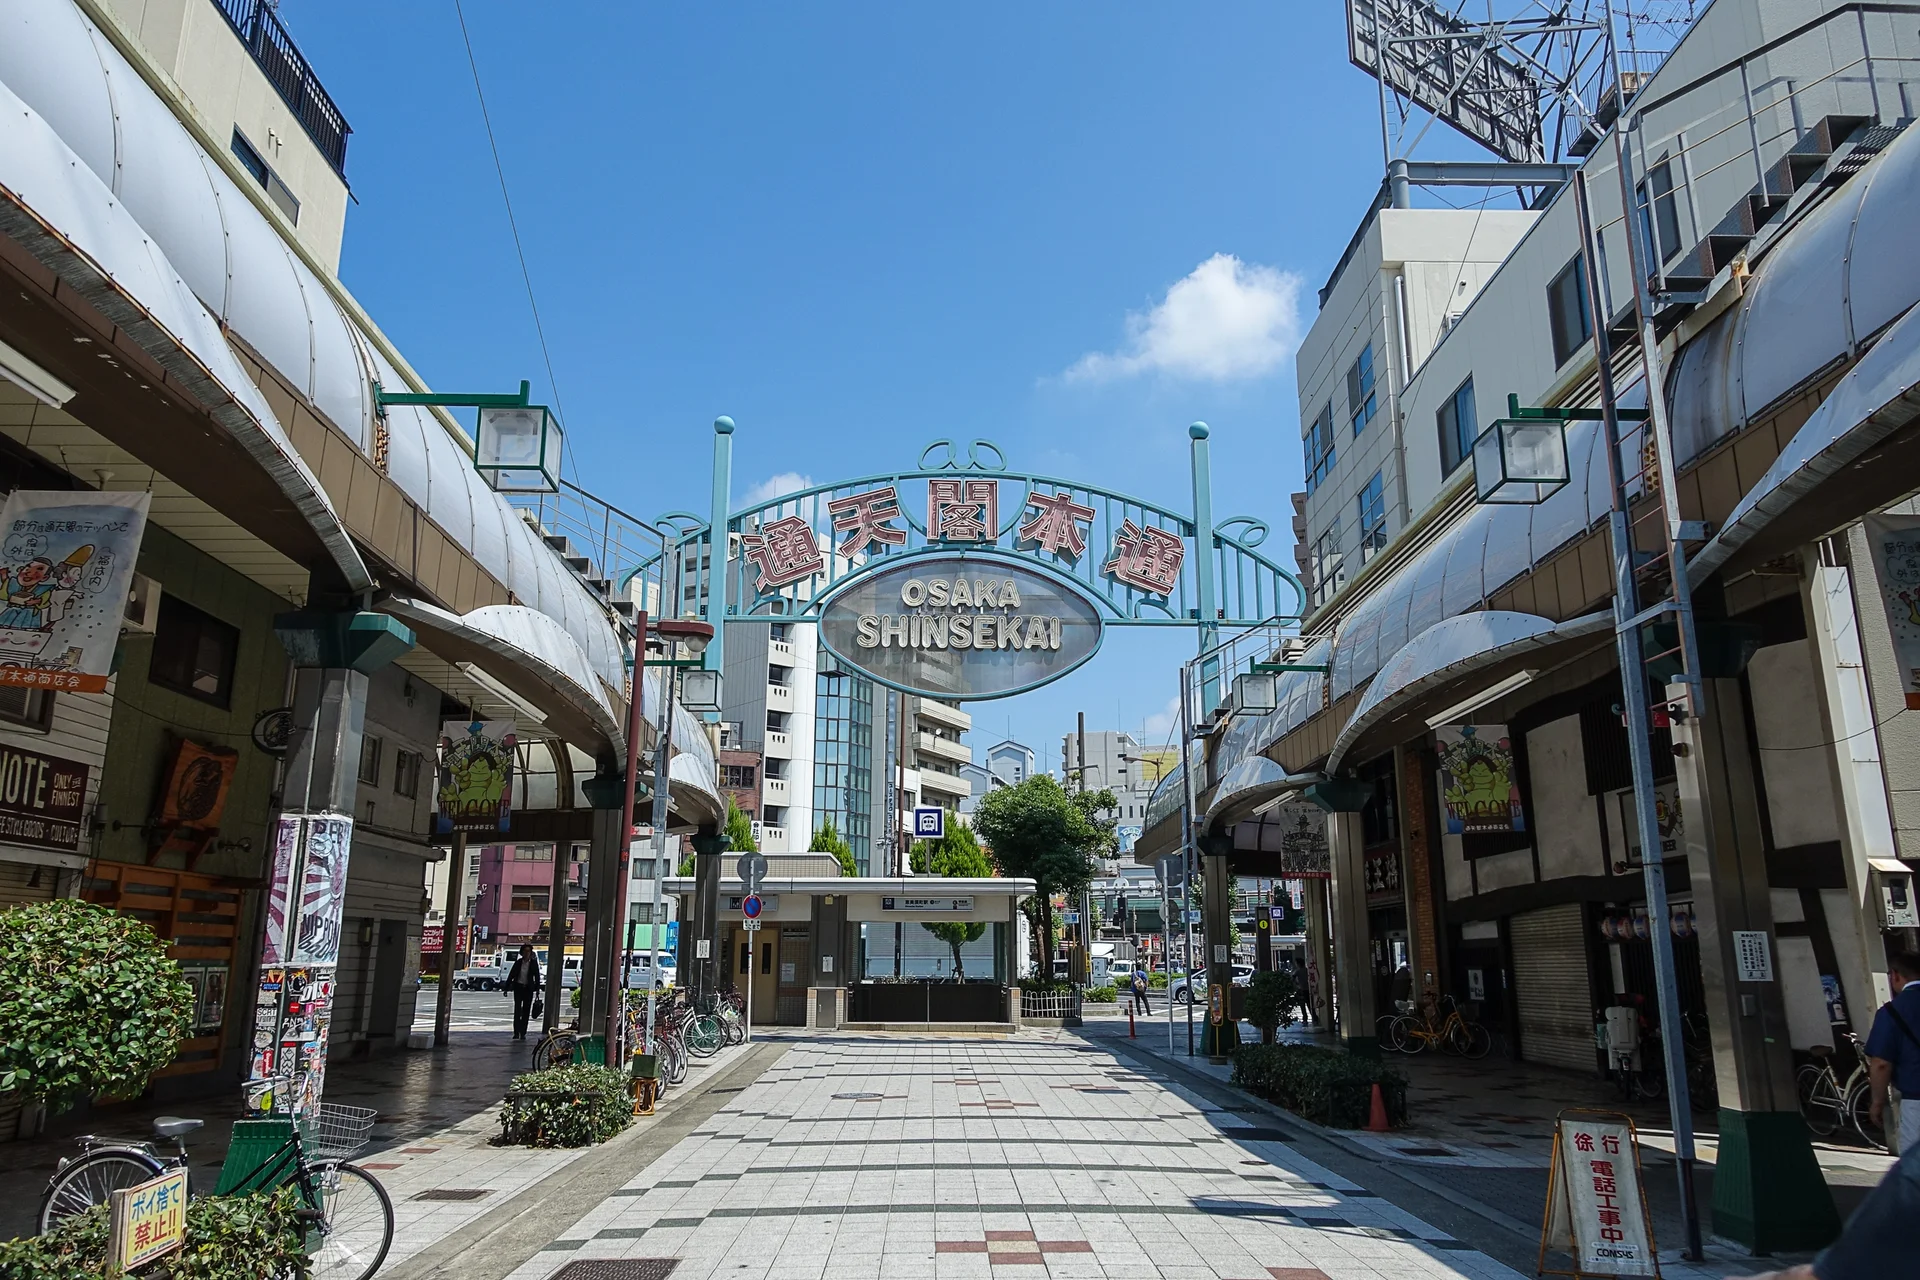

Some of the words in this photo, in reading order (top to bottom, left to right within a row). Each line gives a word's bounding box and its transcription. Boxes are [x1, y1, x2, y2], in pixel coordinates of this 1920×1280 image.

[741, 479, 1186, 596] 通天閣本通
[900, 578, 1021, 609] OSAKA
[856, 613, 1061, 651] SHINSEKAI
[1574, 1132, 1620, 1155] 徐行
[131, 1181, 181, 1222] ポイ捨て
[1590, 1160, 1624, 1244] 電話工事中
